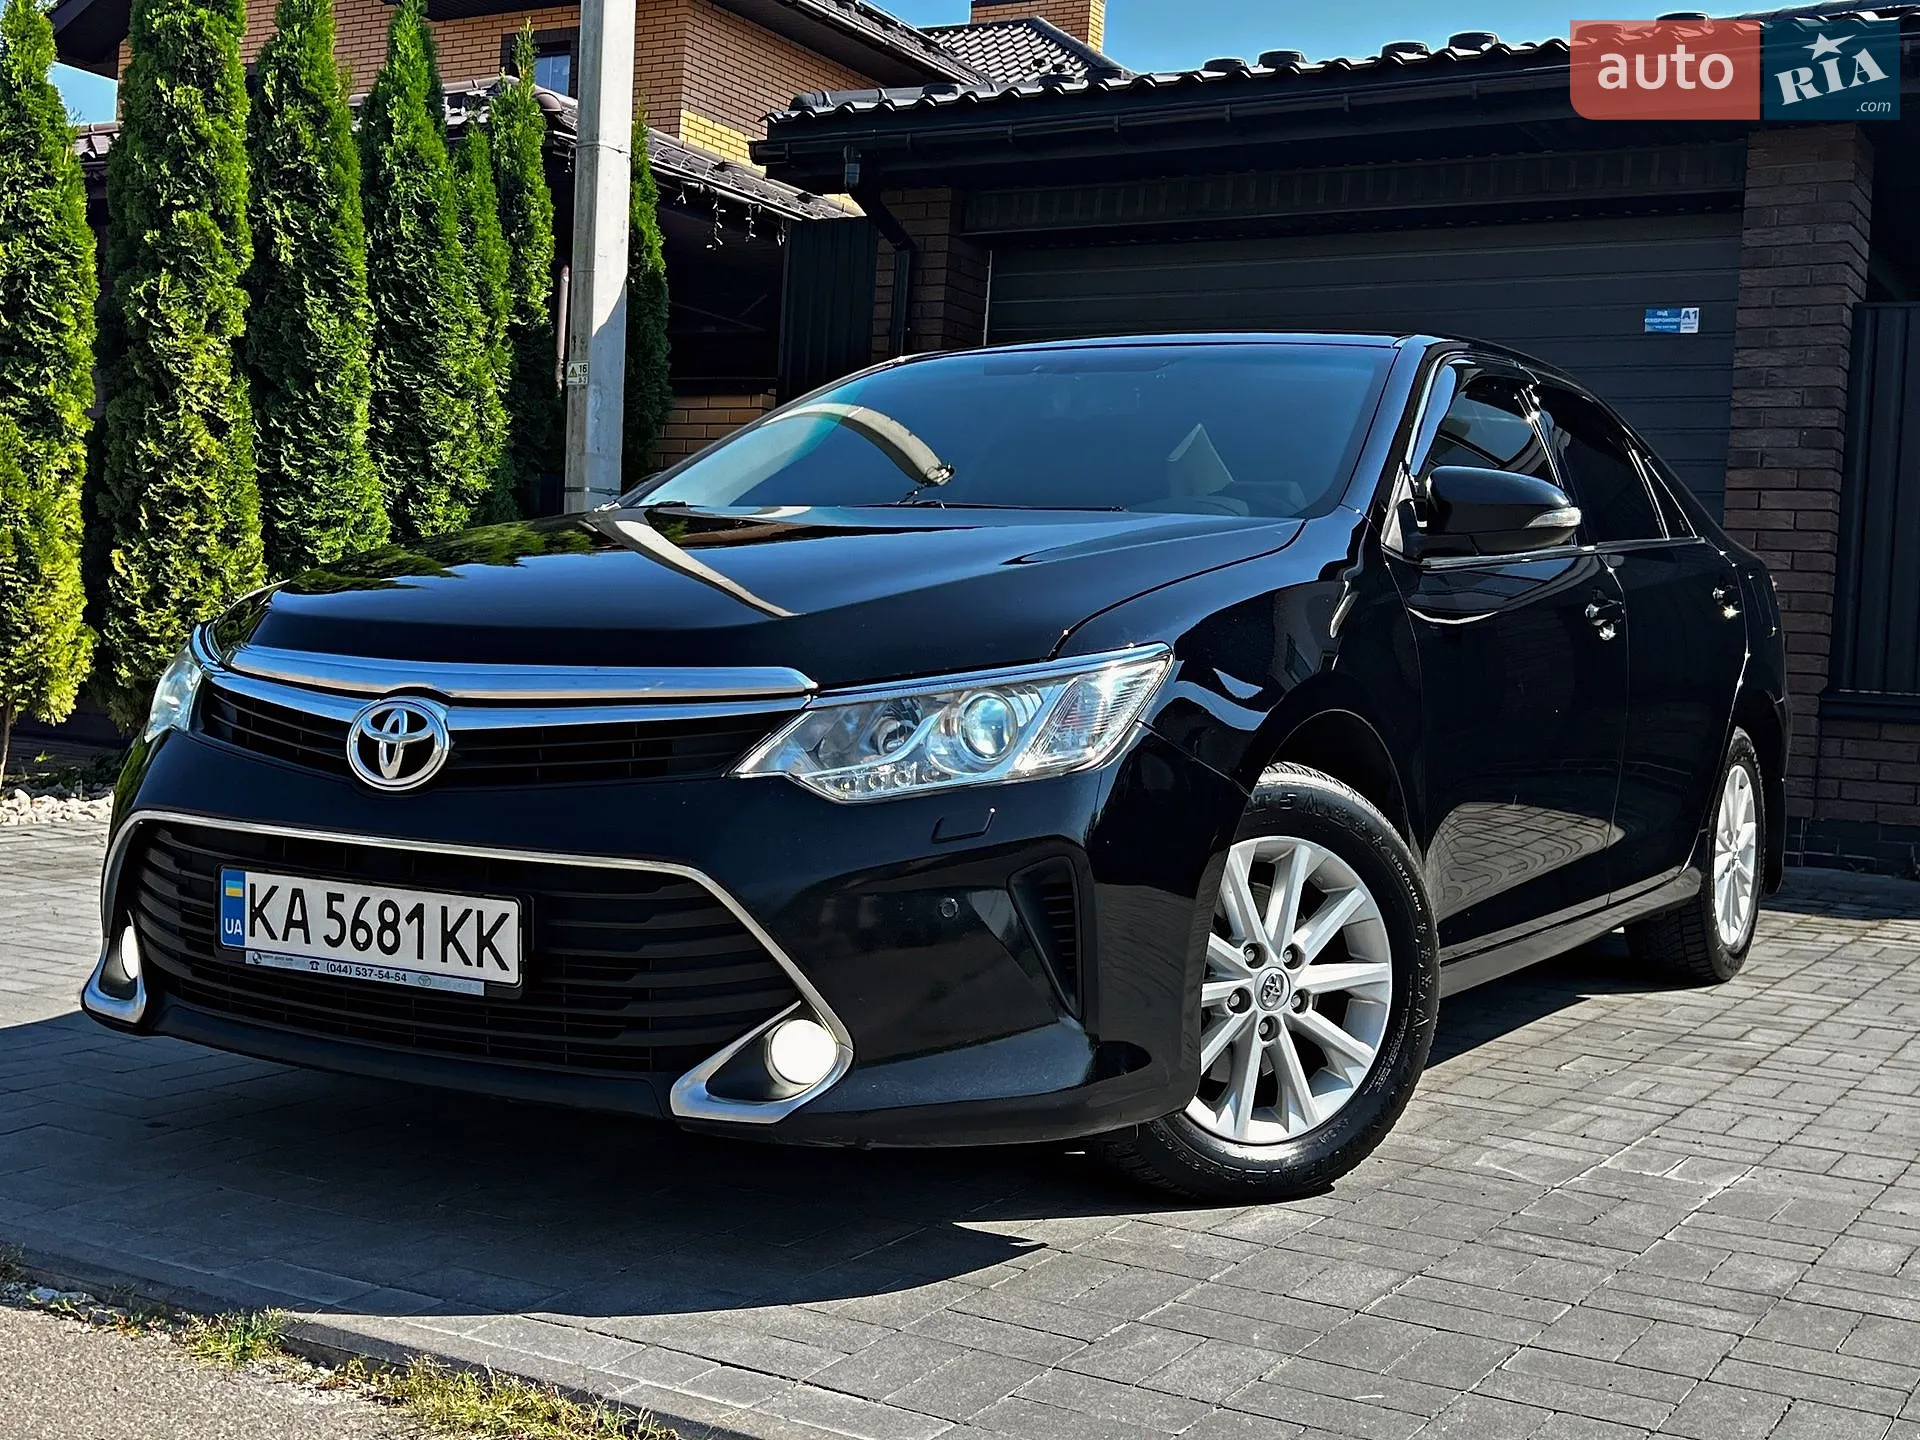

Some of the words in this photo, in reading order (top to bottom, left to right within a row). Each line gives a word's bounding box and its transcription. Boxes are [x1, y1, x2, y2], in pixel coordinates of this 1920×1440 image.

[579, 364, 588, 372] 16
[225, 917, 243, 936] UA
[249, 882, 311, 945] KA
[322, 891, 425, 960] 5681
[440, 905, 510, 972] KK
[326, 960, 353, 975] (044)
